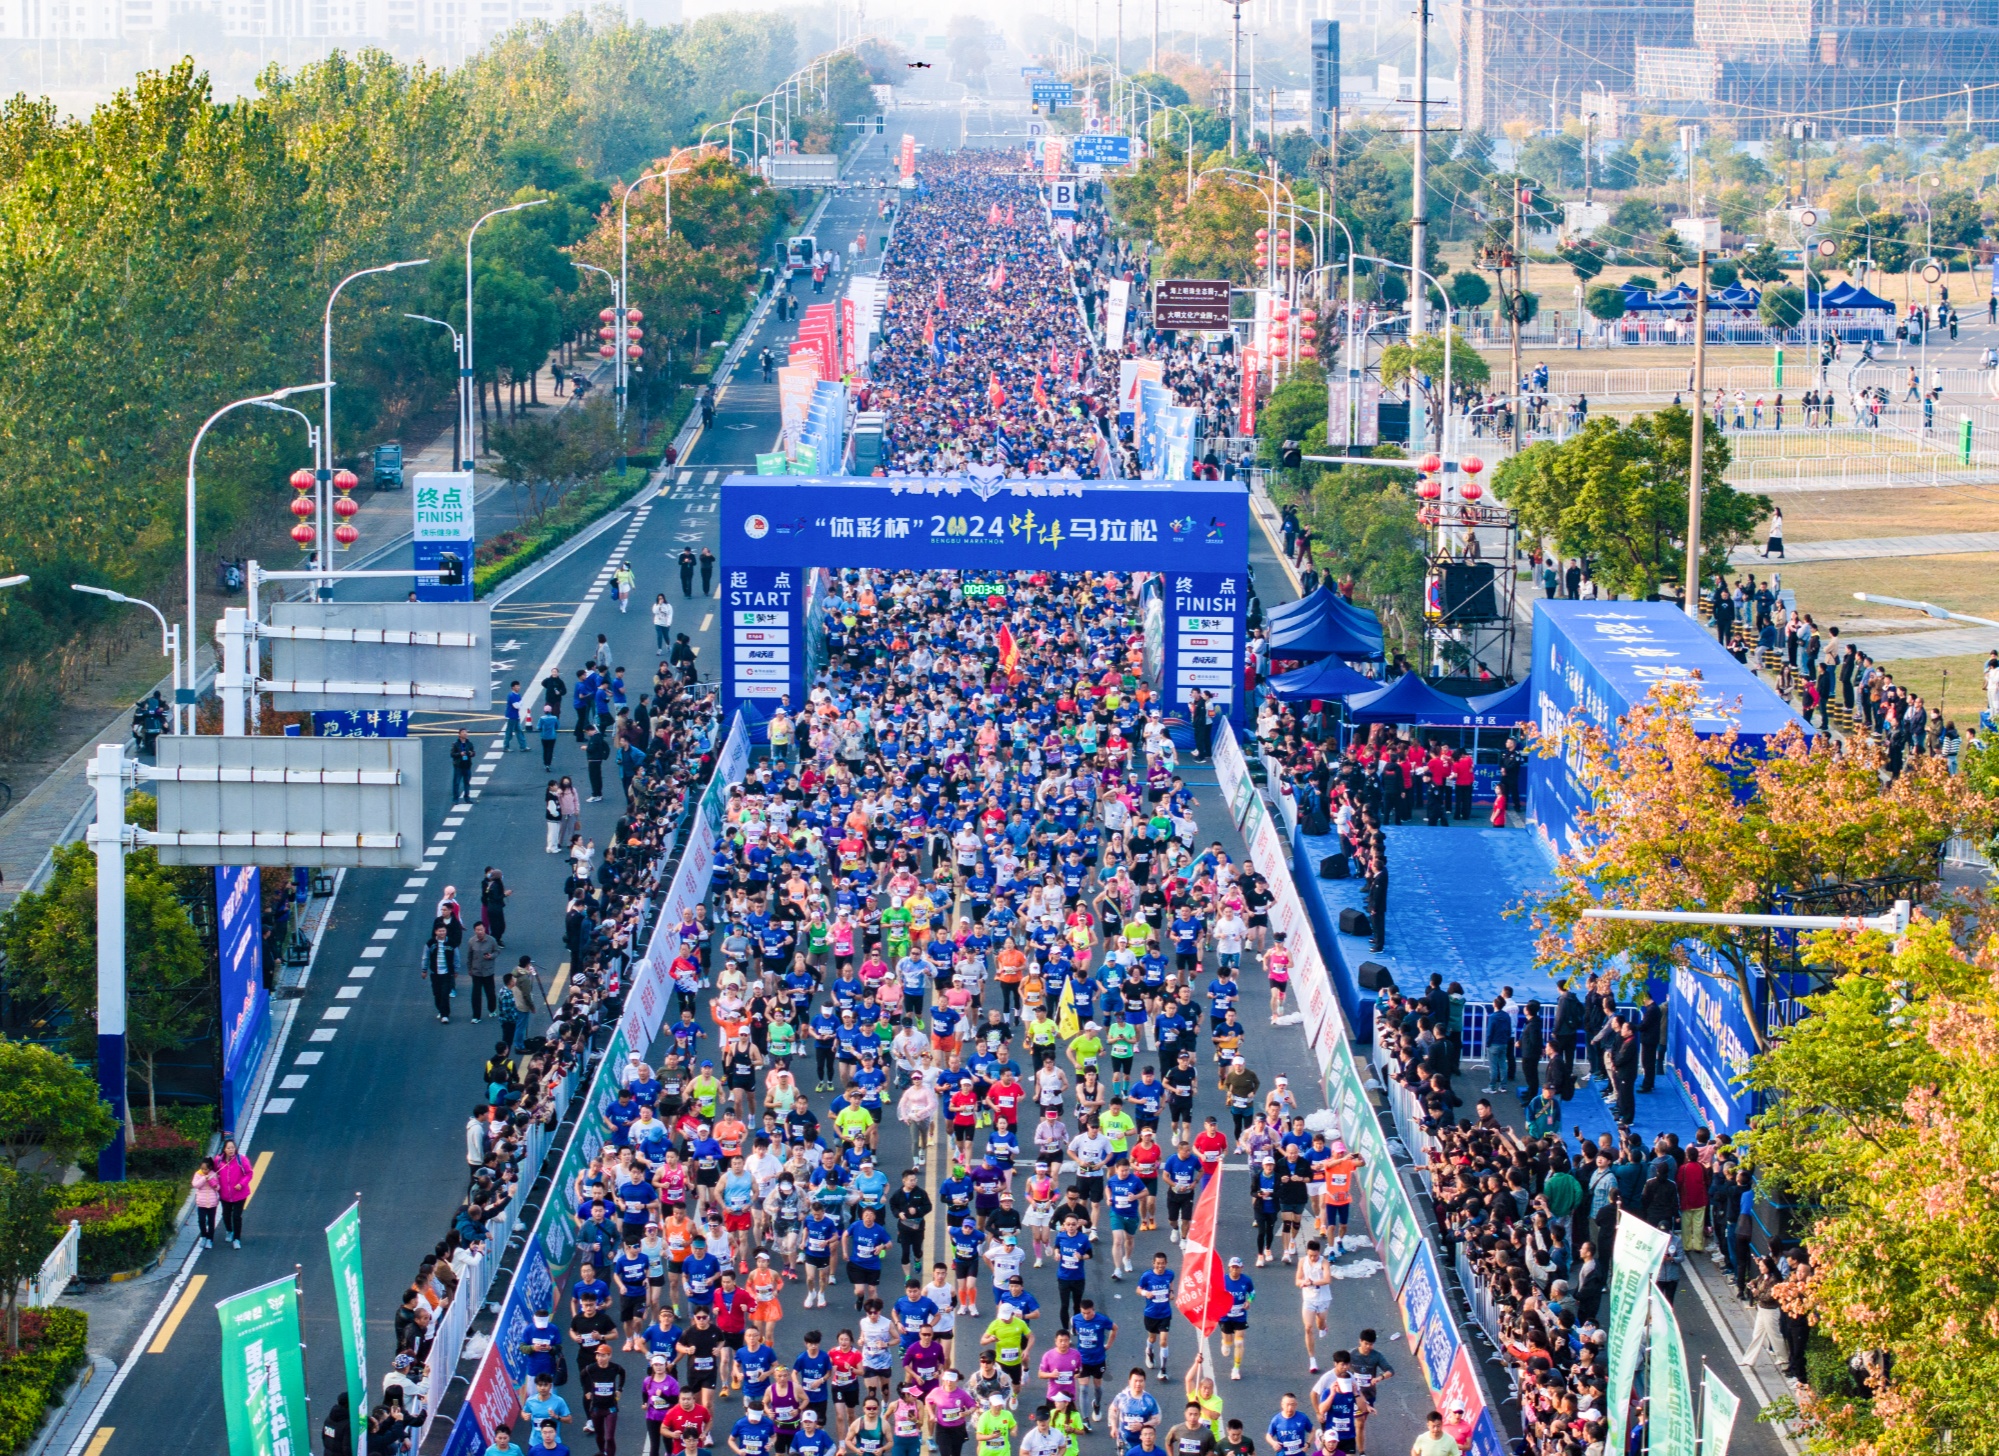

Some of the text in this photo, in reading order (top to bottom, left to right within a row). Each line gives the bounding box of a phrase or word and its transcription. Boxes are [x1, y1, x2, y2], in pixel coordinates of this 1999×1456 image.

[1058, 186, 1070, 203] B
[417, 487, 462, 509] 终点
[418, 512, 463, 522] FINISH
[816, 517, 923, 538] “体彩杯”
[730, 572, 791, 588] 起点
[1176, 577, 1236, 594] 终点
[964, 585, 1004, 594] 00:03:48
[730, 592, 791, 606] START
[1176, 597, 1236, 611] FINISH
[756, 614, 776, 624] 蒙牛
[1201, 620, 1221, 629] 蒙牛
[1464, 716, 1496, 724] 音控区
